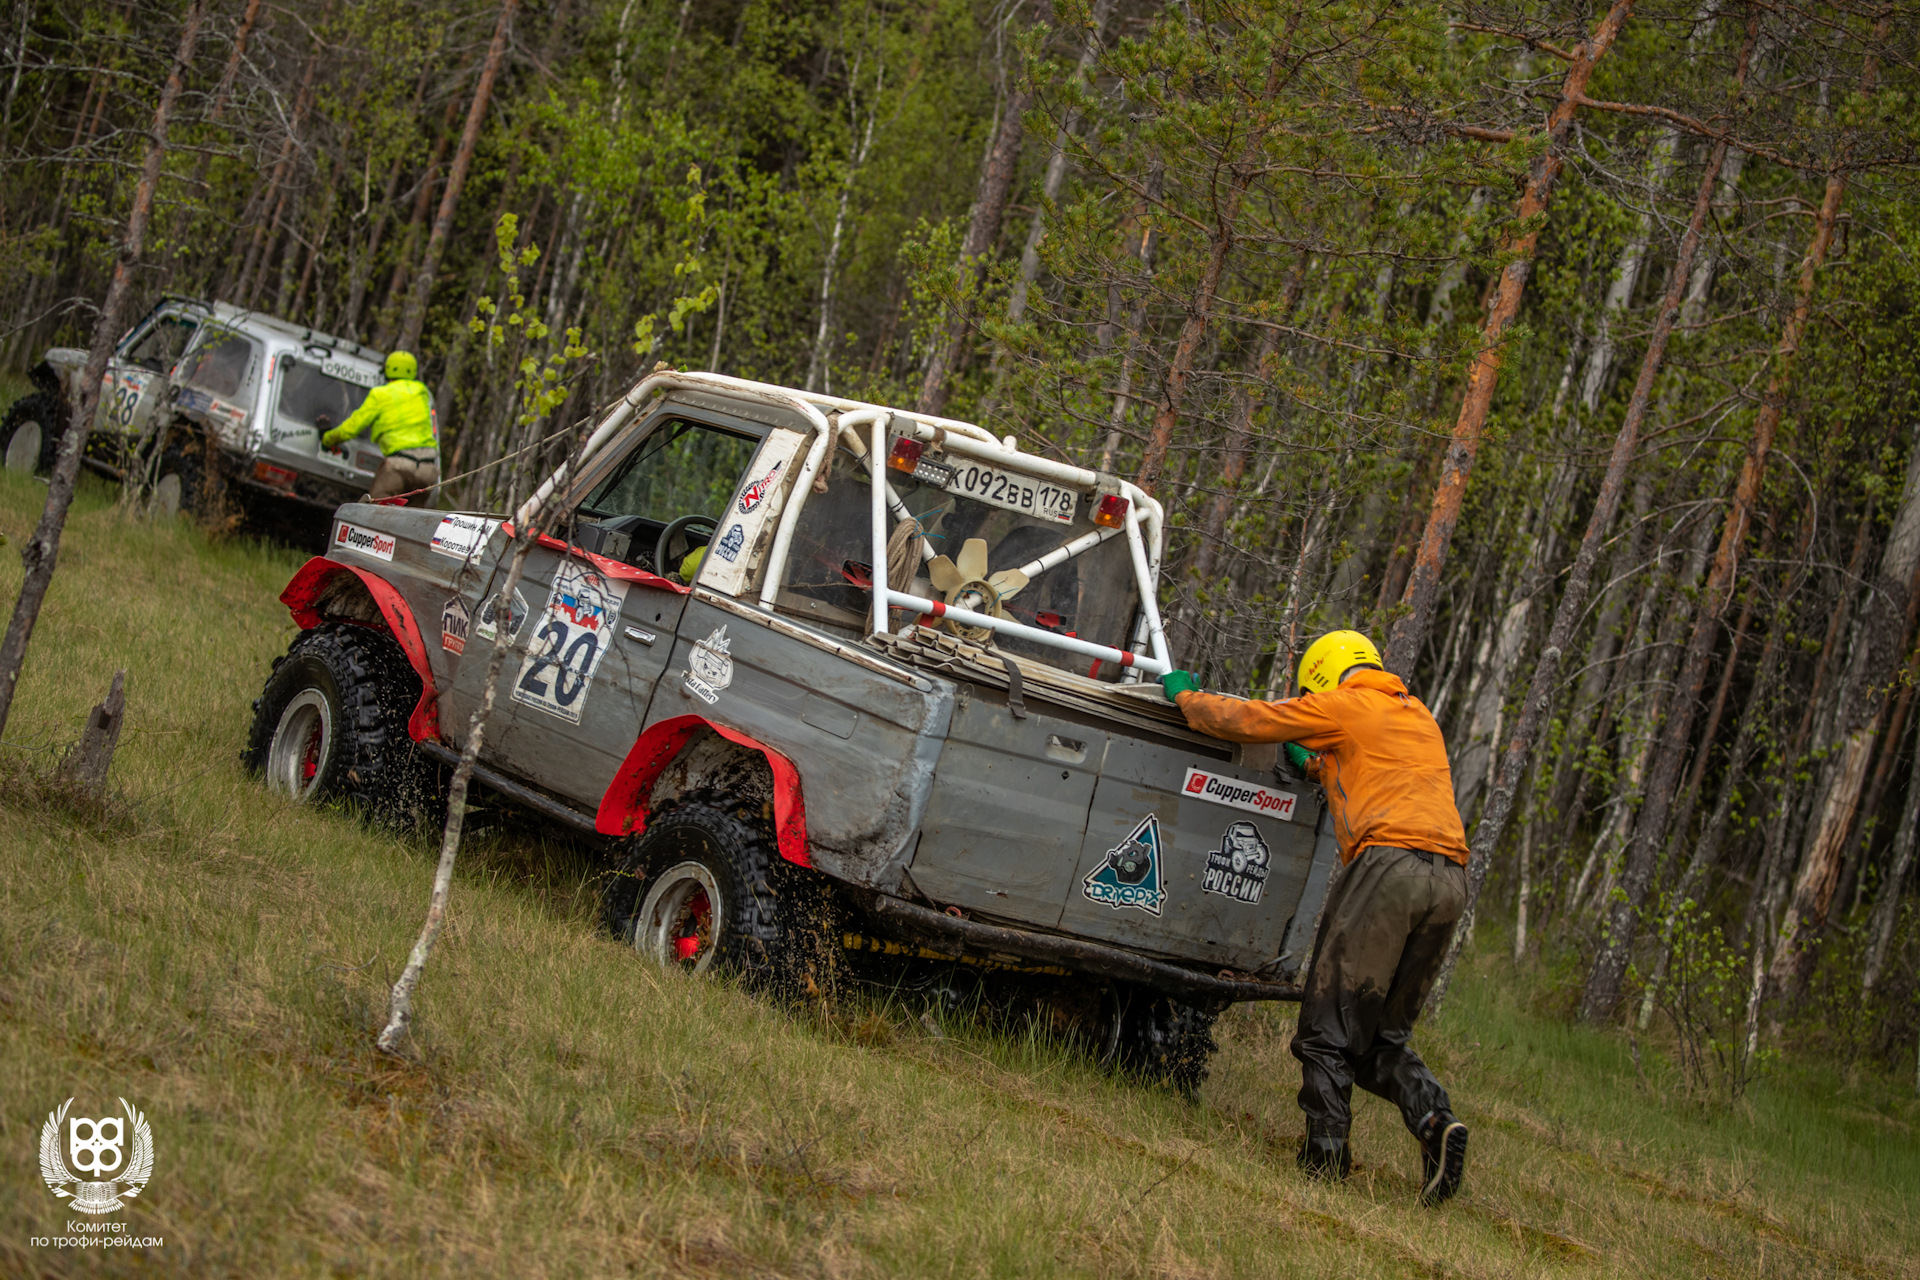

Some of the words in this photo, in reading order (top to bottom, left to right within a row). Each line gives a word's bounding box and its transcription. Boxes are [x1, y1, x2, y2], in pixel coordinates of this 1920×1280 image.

[1040, 486, 1071, 511] 178
[453, 516, 478, 531] Прошин
[1043, 507, 1058, 518] RUS
[348, 527, 394, 554] CupperSport
[444, 612, 469, 640] ПИК
[518, 620, 598, 706] 20
[1206, 778, 1293, 813] CupperSport
[1205, 867, 1262, 902] РОССИИ
